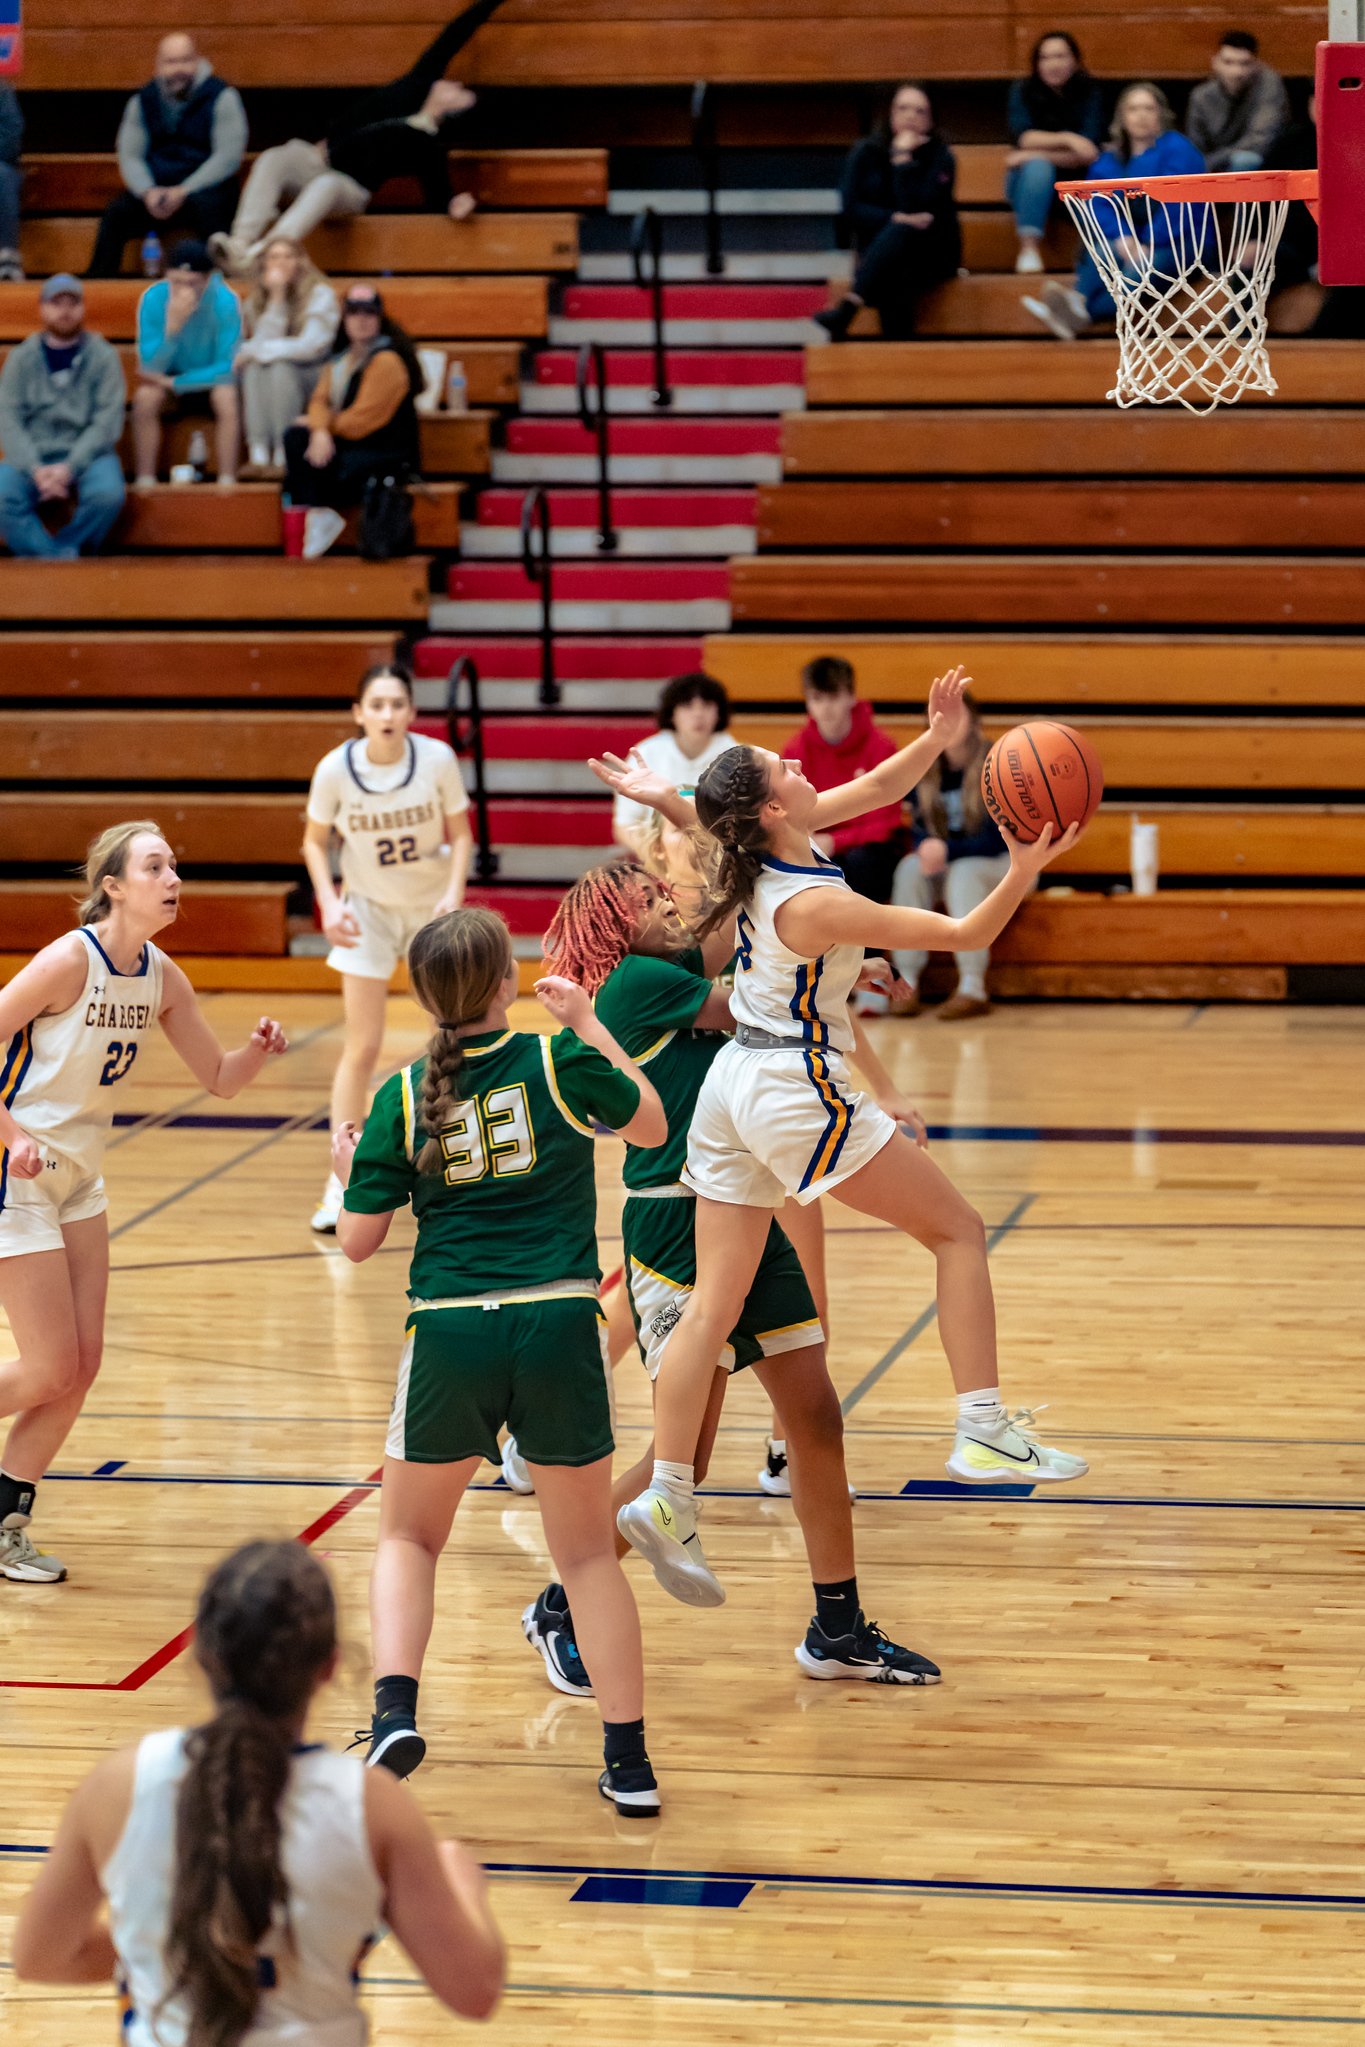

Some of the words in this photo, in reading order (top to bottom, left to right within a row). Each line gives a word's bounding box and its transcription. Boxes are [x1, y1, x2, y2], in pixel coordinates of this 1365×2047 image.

[1007, 749, 1041, 820] EVOLUTION
[348, 801, 434, 832] CHARGERS
[376, 836, 419, 866] 22
[440, 1082, 537, 1186] 33
